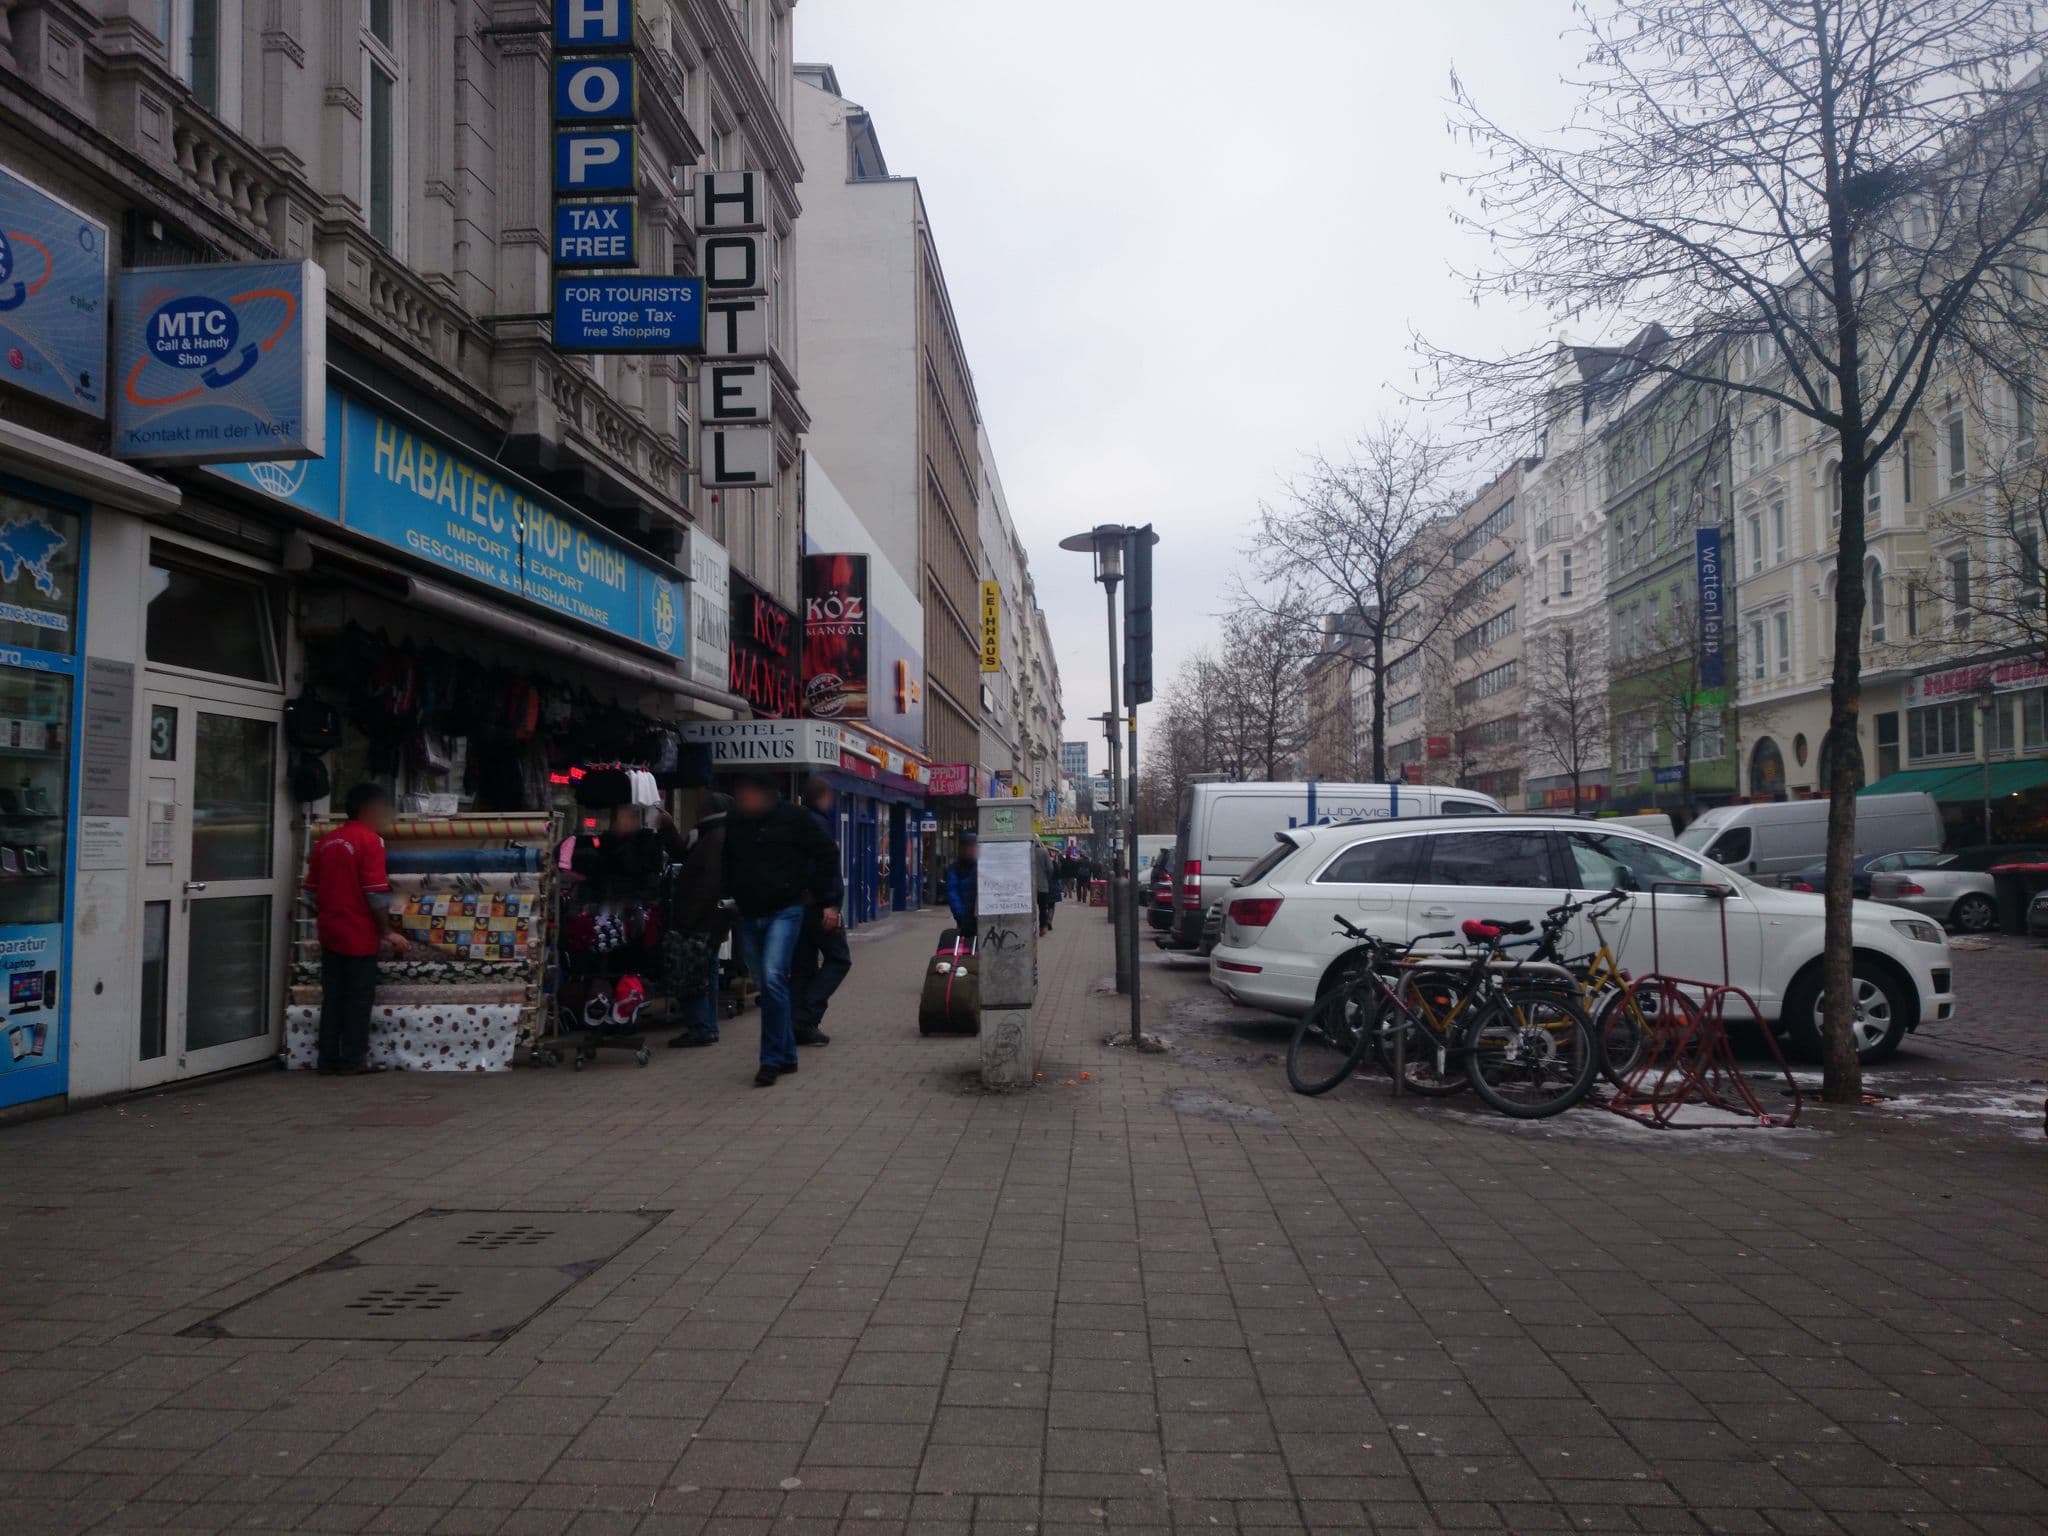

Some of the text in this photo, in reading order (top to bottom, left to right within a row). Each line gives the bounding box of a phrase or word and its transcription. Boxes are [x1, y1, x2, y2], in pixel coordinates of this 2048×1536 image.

[568, 208, 619, 231] TAX
[560, 236, 626, 257] FREE
[564, 287, 693, 302] FOR TOURISTS
[158, 310, 227, 338] MTC
[581, 308, 677, 324] Europe Tax-
[704, 171, 757, 483] HOTEL
[583, 325, 671, 338] free Shopping
[156, 337, 230, 352] Call & Handy
[178, 353, 207, 368] Shop
[198, 426, 222, 440] mit
[224, 424, 249, 439] der
[373, 417, 627, 593] HABATEC SHOP GmbH
[446, 519, 585, 593] IMPORT & EXPORT
[405, 528, 610, 627] GESCHENK & HAUSHALTWARE
[805, 590, 864, 621] KÖZ
[805, 625, 864, 638] MANGAL
[986, 587, 996, 666] LEIHHAUS
[152, 715, 170, 755] 3
[1317, 807, 1390, 817] LUDWIG
